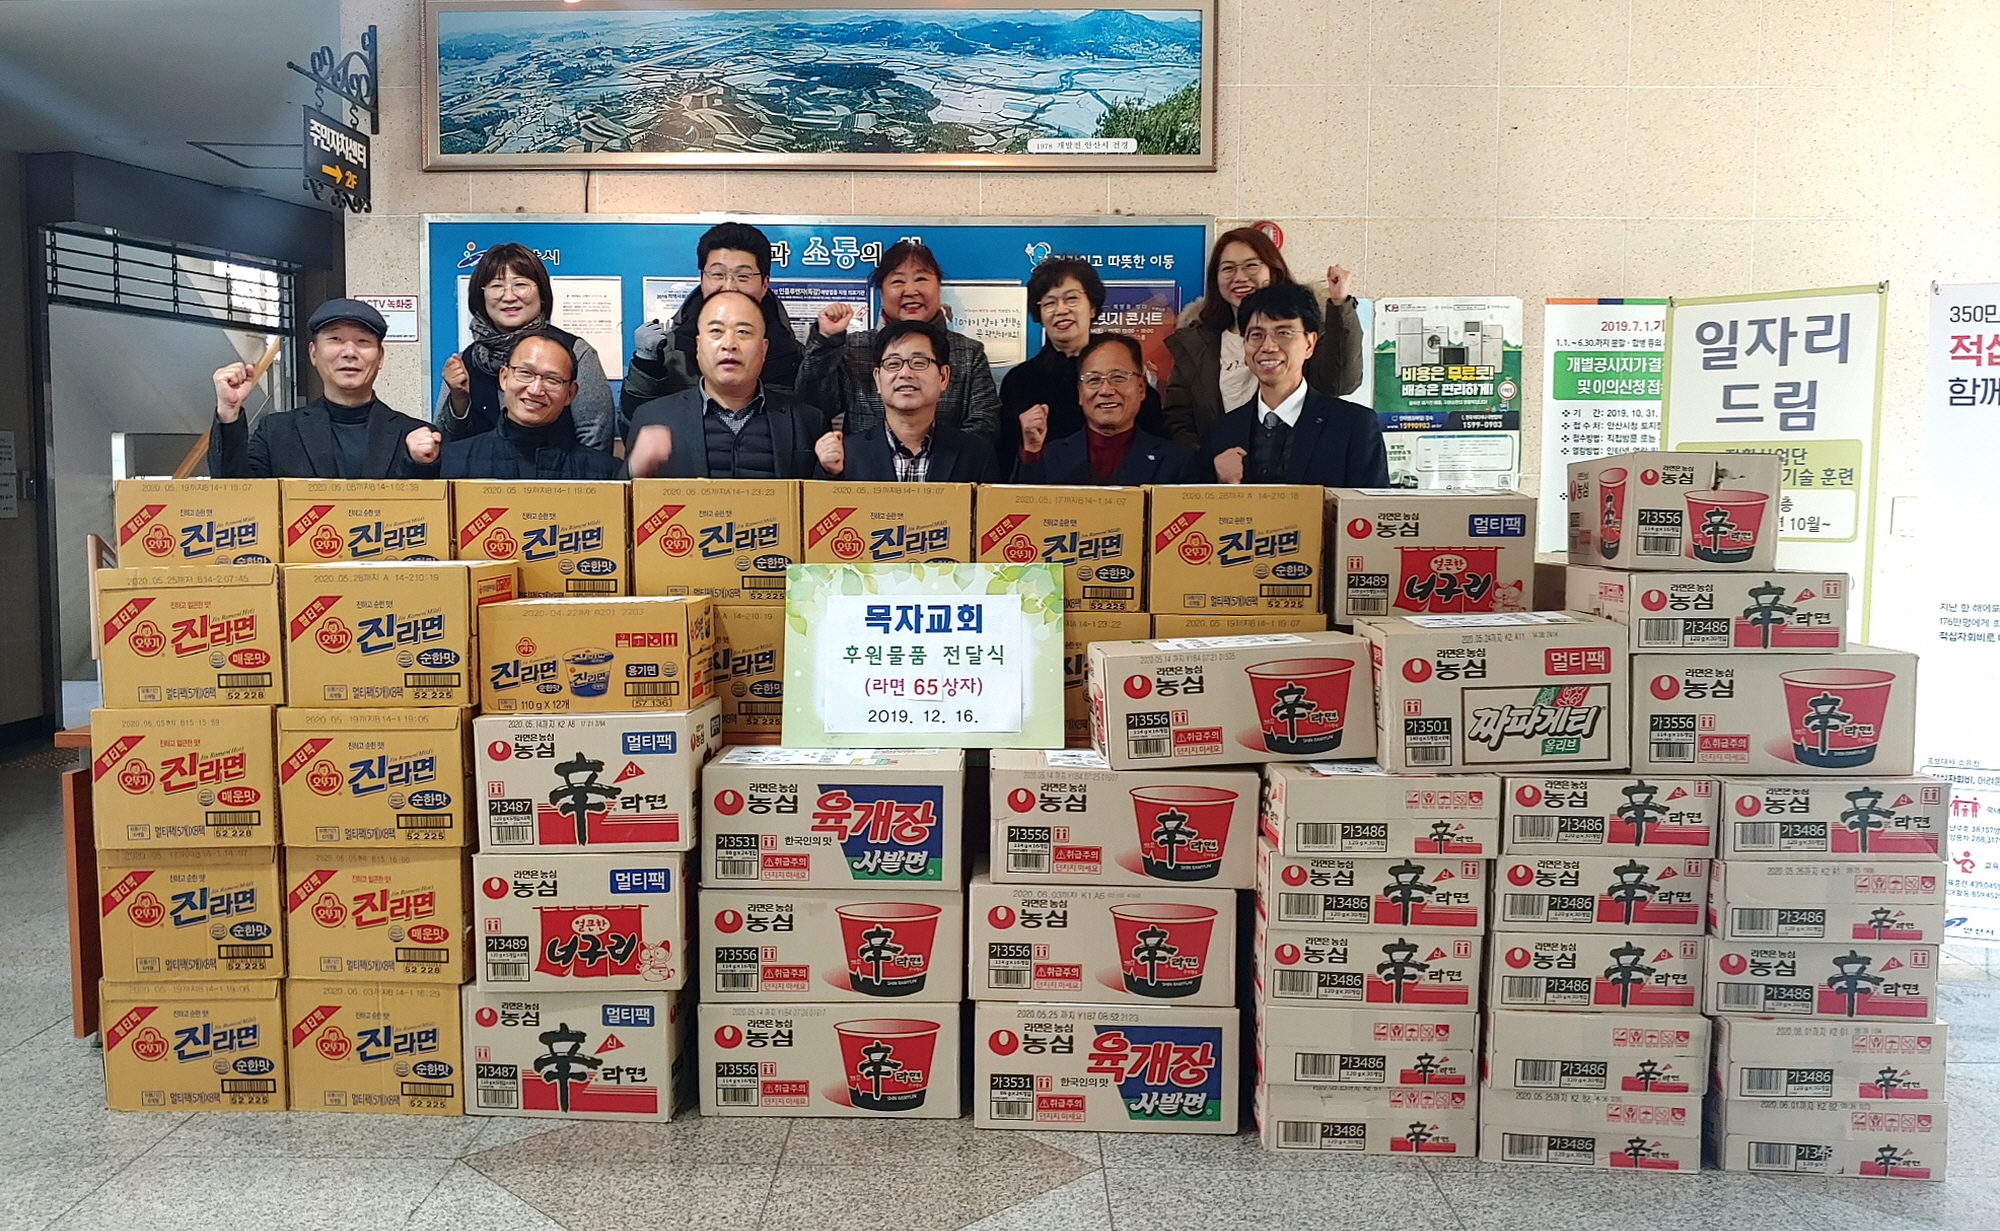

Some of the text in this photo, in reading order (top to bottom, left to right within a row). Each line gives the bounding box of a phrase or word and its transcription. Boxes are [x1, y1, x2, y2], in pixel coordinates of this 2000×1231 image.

[310, 119, 366, 169] 주민자치센터
[1057, 141, 1081, 149] 개발전
[1085, 141, 1108, 149] 안산시
[1113, 141, 1128, 149] 전경
[345, 171, 357, 189] 2F
[802, 237, 882, 269] 소통의
[1108, 255, 1145, 269] 따뜻한
[1150, 255, 1175, 269] 이동
[388, 300, 412, 309] 녹화중
[1092, 312, 1163, 326] 릿지 콘서트
[1695, 312, 1850, 371] 일자리
[1567, 357, 1664, 372] 개별공시지가 결
[1402, 366, 1494, 381] 비용은 무료로!
[1402, 384, 1493, 396] 배출은 편리하게!
[1578, 379, 1662, 395] 및 이의신청 접
[1607, 409, 1628, 417] 2019.
[1632, 409, 1643, 417] 10.
[1646, 409, 1658, 417] 31.
[1716, 380, 1818, 432] 드림
[1661, 472, 1694, 485] 농심
[1783, 468, 1853, 486] 기술 훈련
[1473, 517, 1522, 534] 멀티팩
[149, 539, 171, 550] 오뚜기
[180, 520, 259, 559] 진라면
[521, 523, 604, 563] 진라면
[1041, 530, 1124, 568] 진라면
[1184, 547, 1207, 557] 오뚜기
[756, 556, 791, 569] 순한맛
[1276, 564, 1309, 577] 순한맛
[1349, 576, 1387, 587] 가3489
[1406, 573, 1492, 603] 너구리
[1940, 603, 1957, 612] 지난
[1961, 603, 1970, 612] 한
[865, 604, 983, 634] 목자교회
[1685, 622, 1728, 634] 가3486
[171, 614, 257, 659] 진라면
[1939, 632, 1995, 642] 적십자회비로
[232, 651, 268, 666] 매운맛
[419, 652, 457, 666] 순한맛
[843, 645, 1004, 665] 후원물품 전달식
[1550, 651, 1605, 671] 멀티팩
[490, 658, 558, 692] 진라면
[627, 665, 657, 676] 용기면
[1435, 658, 1486, 679] 농심
[865, 678, 905, 697] (라면
[1683, 679, 1734, 698] 농심
[521, 700, 535, 710] 110
[536, 702, 542, 712] g
[552, 698, 570, 710] 12개
[868, 710, 979, 724] 2019. 12. 16.
[1128, 714, 1168, 727] 가3556
[1310, 711, 1338, 723] 라면
[1652, 717, 1694, 729] 가3556
[1407, 720, 1449, 733] 가3501
[1469, 705, 1601, 750] 짜파게티
[627, 735, 672, 751] 멀티팩
[1544, 739, 1577, 752] 올리브
[160, 752, 246, 795] 진라면
[620, 794, 668, 813] 라면
[747, 794, 798, 814] 농심
[1544, 791, 1588, 808] 농심
[490, 802, 530, 813] 가3487
[811, 791, 936, 843] 육개장
[1009, 828, 1049, 841] 가3556
[1343, 825, 1386, 837] 가3486
[1782, 824, 1826, 837] 가3486
[718, 836, 758, 848] 가3531
[785, 836, 832, 846] 한국인의 맛
[774, 857, 807, 867] 취급주의
[615, 872, 665, 890] 멀티팩
[1310, 869, 1354, 887] 농심
[512, 880, 557, 897] 농심
[1436, 891, 1470, 905] 라면
[1551, 897, 1592, 909] 가3486
[168, 887, 258, 927] 진라면
[1020, 909, 1067, 928] 농심
[232, 924, 269, 938] 순한맛
[411, 927, 446, 941] 매운맛
[488, 938, 527, 950] 가3489
[548, 934, 636, 965] 너구리
[718, 949, 757, 961] 가3556
[1533, 953, 1576, 969] 농심
[1749, 959, 1796, 977] 농심
[1319, 974, 1362, 986] 가3486
[1766, 988, 1811, 999] 가3486
[607, 1008, 650, 1024] 멀티팩
[173, 1022, 261, 1063] 진라면
[746, 1029, 793, 1048] 농심
[1086, 1032, 1215, 1085] 육개장
[415, 1063, 451, 1077] 순한맛
[478, 1066, 516, 1077] 가3487
[1562, 1063, 1605, 1075] 가3486
[895, 1071, 922, 1082] 라면
[992, 1076, 1032, 1089] 가3531
[1323, 1125, 1364, 1137] 가3486
